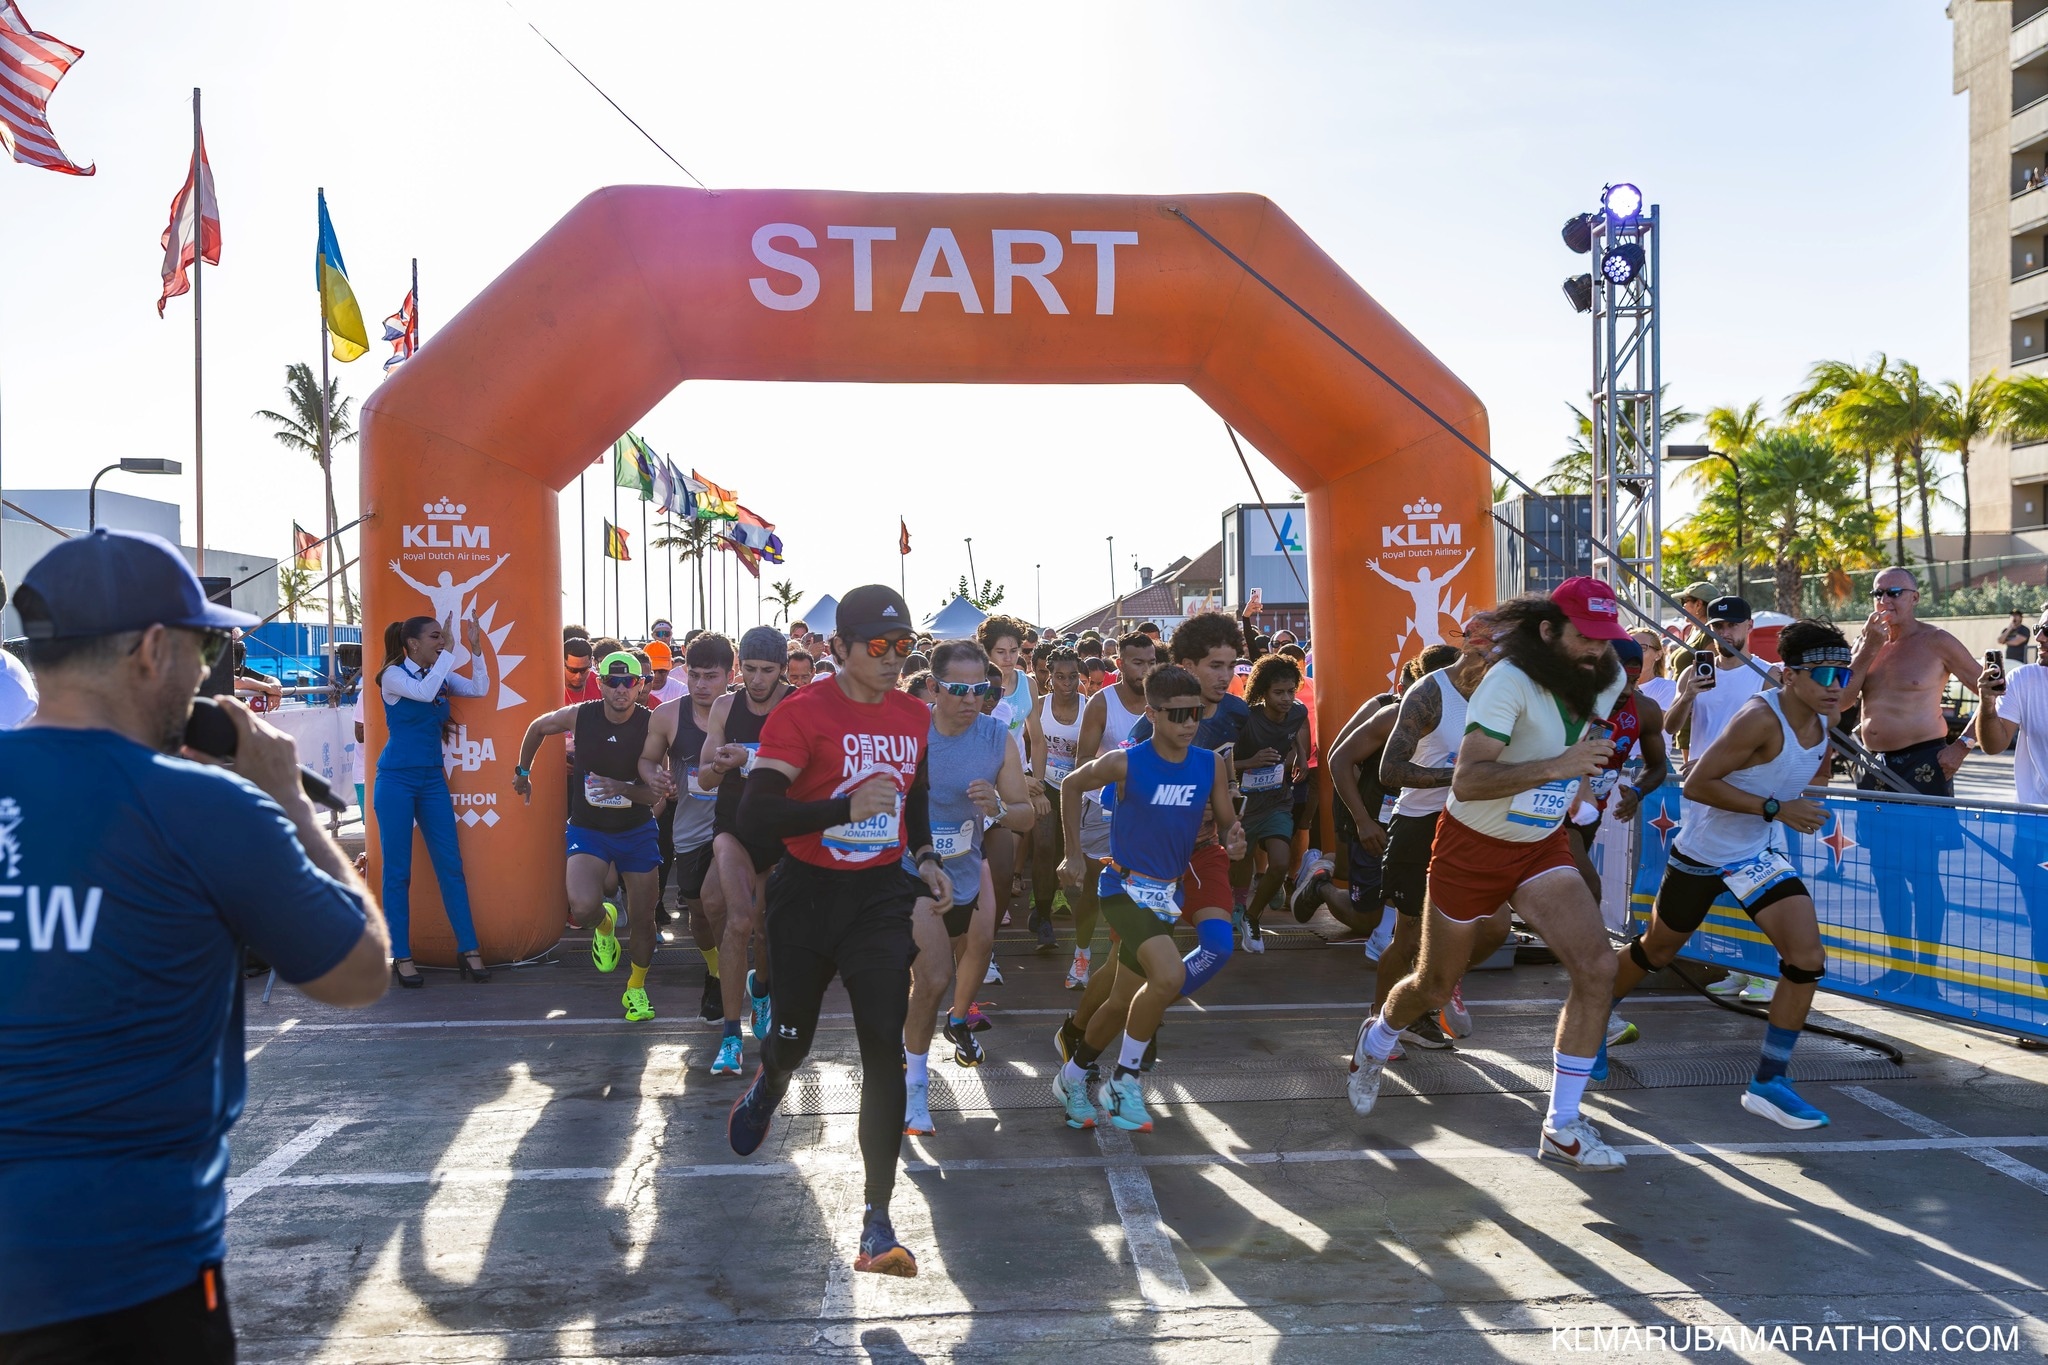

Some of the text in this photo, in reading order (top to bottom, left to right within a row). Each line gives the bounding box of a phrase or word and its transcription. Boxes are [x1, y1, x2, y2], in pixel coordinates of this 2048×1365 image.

[748, 222, 1139, 315] START
[403, 524, 490, 549] KLM
[1382, 523, 1461, 548] KLM
[403, 552, 490, 562] Royal Dutch Airines
[1382, 548, 1462, 560] Royal Dutch Airlines
[872, 735, 918, 764] RUN
[900, 762, 916, 775] 2025
[1253, 774, 1276, 784] 1617
[1150, 784, 1197, 807] NIKE
[1533, 793, 1565, 809] 1796
[1533, 806, 1557, 816] ARUBA
[843, 829, 888, 838] JONATHAN
[1752, 867, 1776, 885] ARUBA
